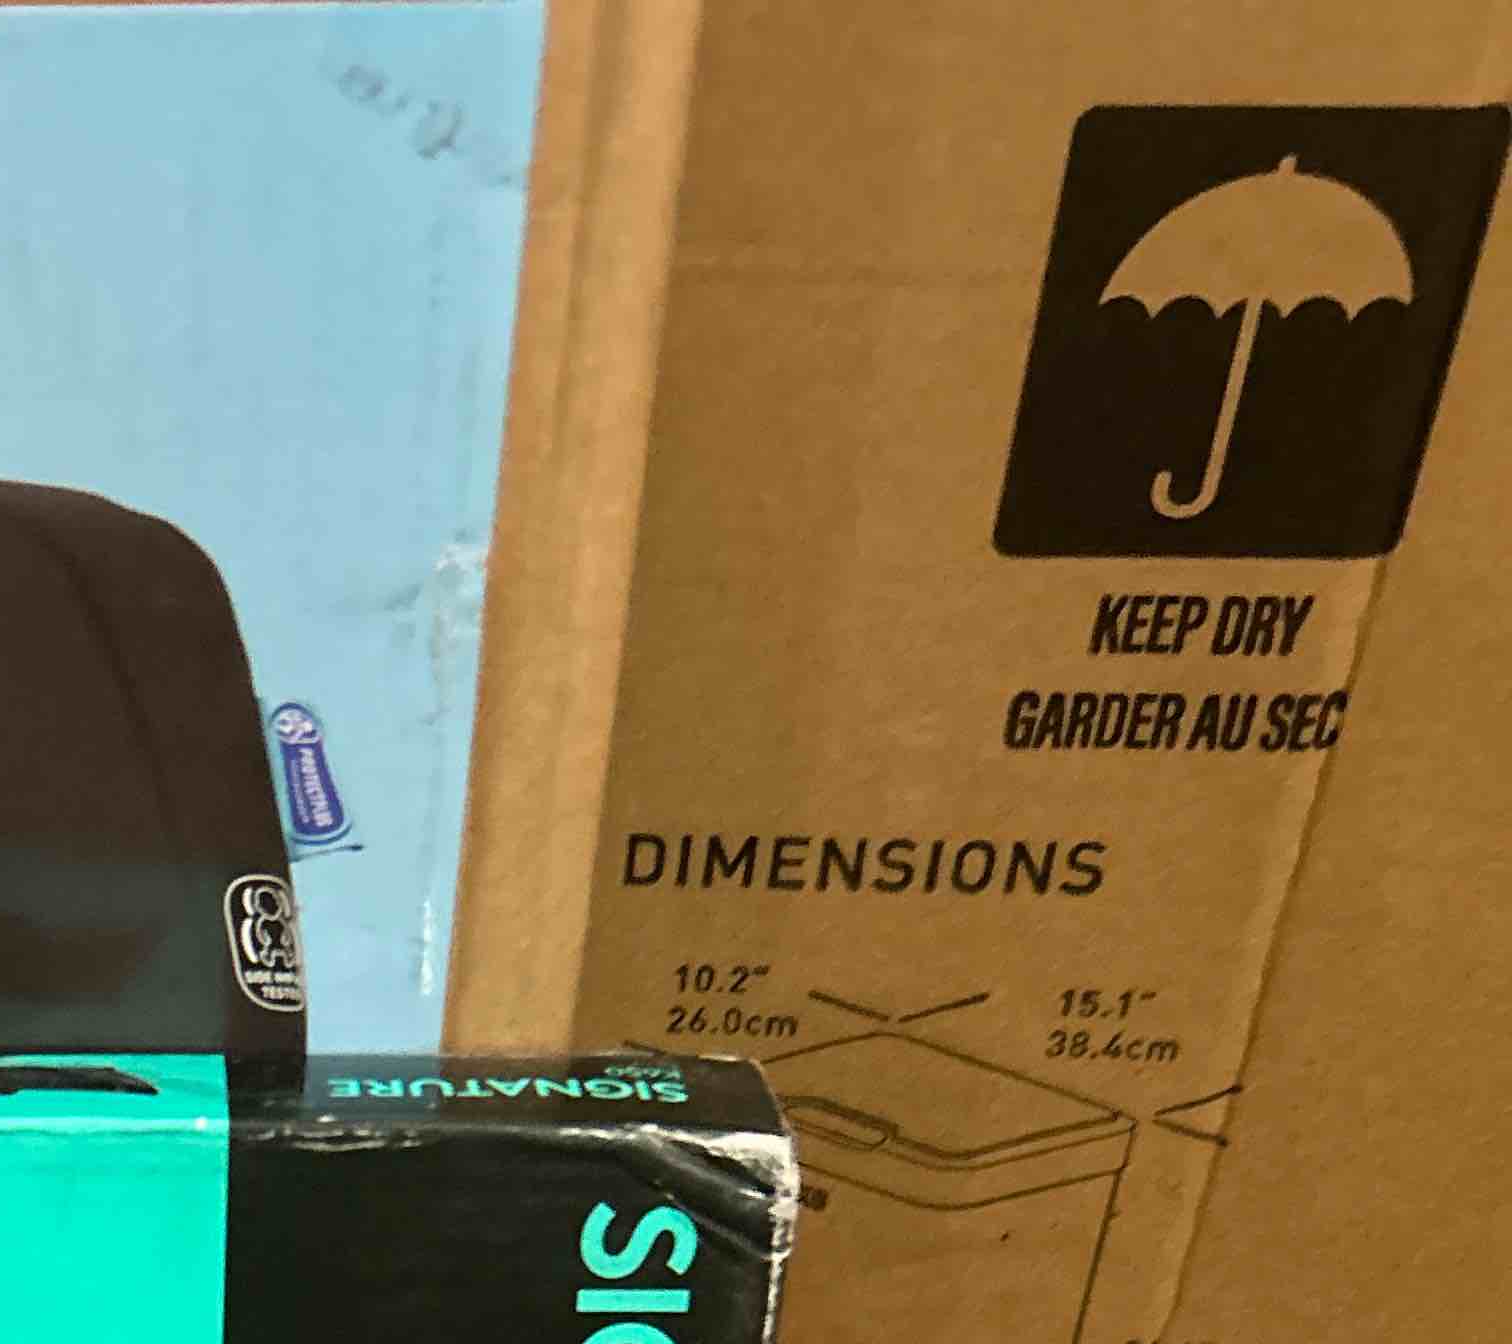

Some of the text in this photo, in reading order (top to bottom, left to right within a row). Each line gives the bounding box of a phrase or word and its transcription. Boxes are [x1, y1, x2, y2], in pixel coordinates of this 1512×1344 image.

[1089, 594, 1314, 656] KEEP DRY
[1003, 690, 1348, 753] GARDER AU SEC
[622, 833, 1106, 896] DIMENSIONS
[675, 964, 770, 993] 10.2"
[666, 1005, 799, 1037] 26.0cm
[1044, 1031, 1181, 1062] 38.4cm
[328, 1075, 688, 1104] SIGNATURE
